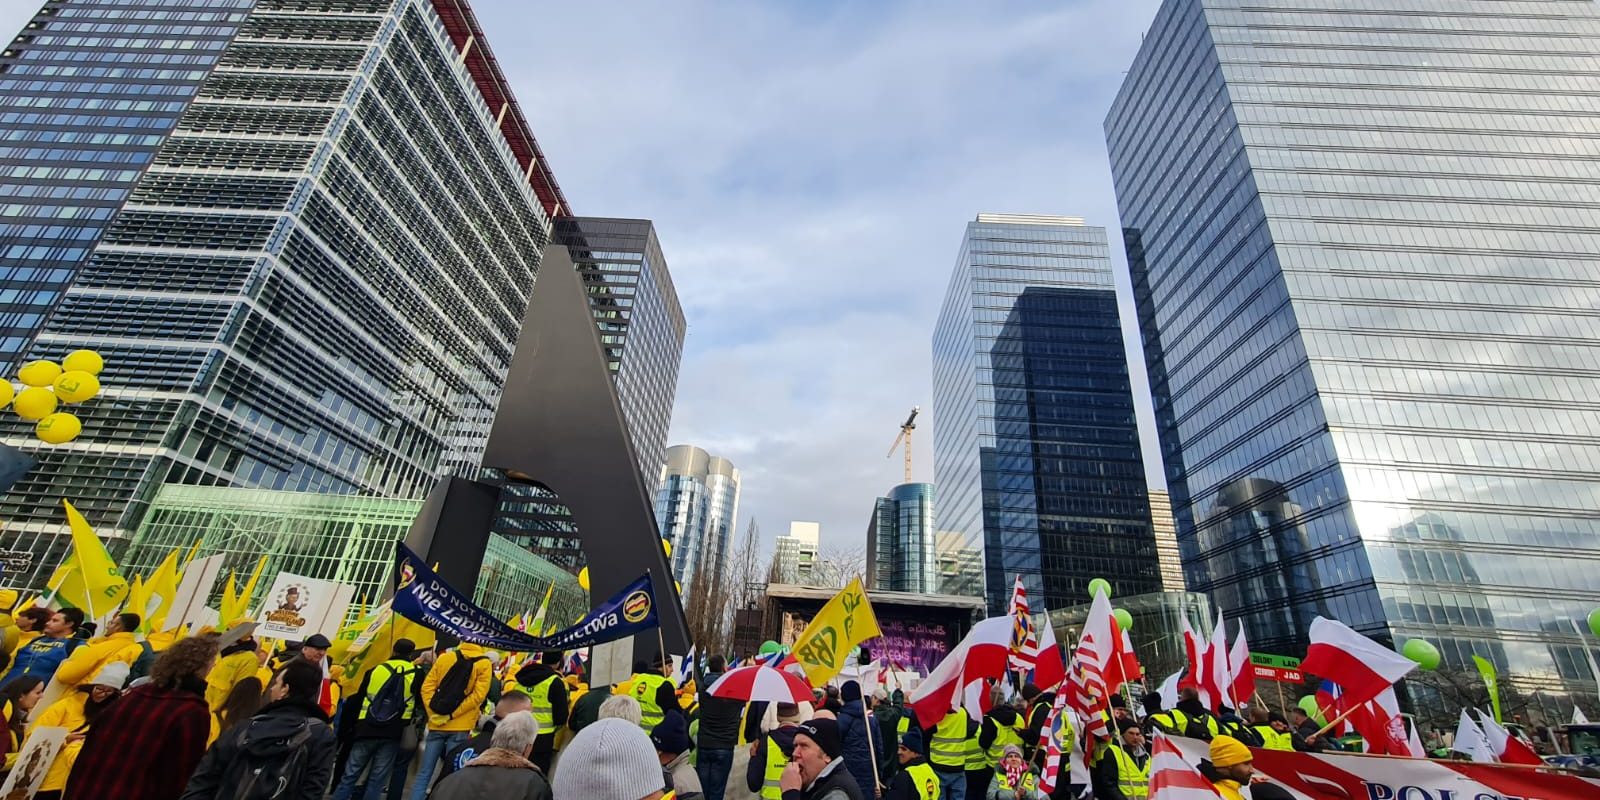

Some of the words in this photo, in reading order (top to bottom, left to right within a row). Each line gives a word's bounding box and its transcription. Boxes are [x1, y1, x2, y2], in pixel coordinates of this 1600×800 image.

[411, 583, 441, 611] Nie
[430, 580, 448, 598] DO
[450, 595, 476, 616] NOT
